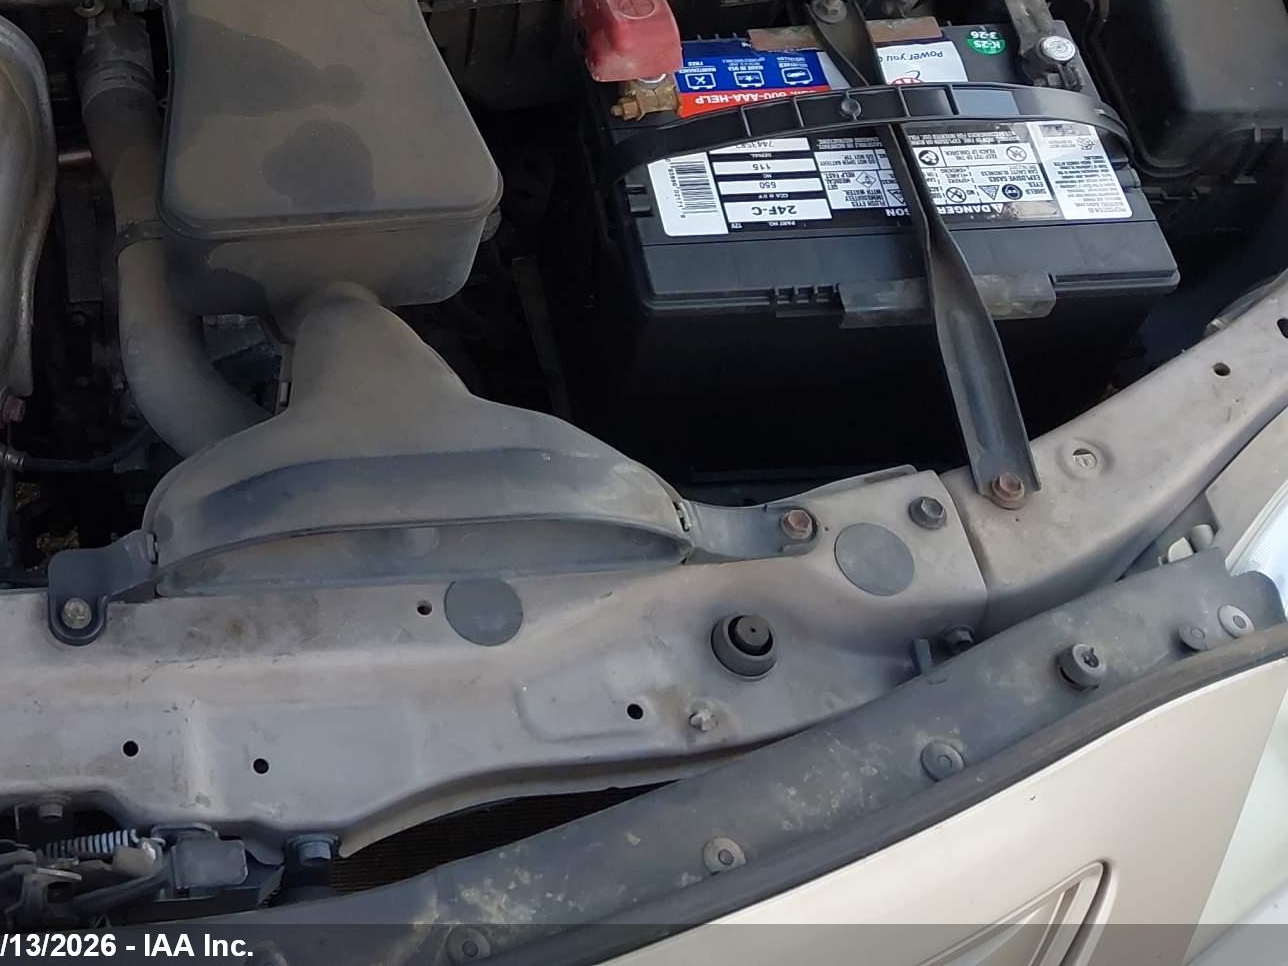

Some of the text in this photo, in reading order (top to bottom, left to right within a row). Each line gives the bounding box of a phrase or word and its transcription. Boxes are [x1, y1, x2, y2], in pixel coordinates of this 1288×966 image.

[970, 31, 998, 39] 3-26
[974, 41, 1000, 49] K-25
[886, 53, 907, 62] you
[909, 50, 944, 60] Power
[752, 205, 797, 216] 24F-C
[938, 204, 991, 213] DANGER
